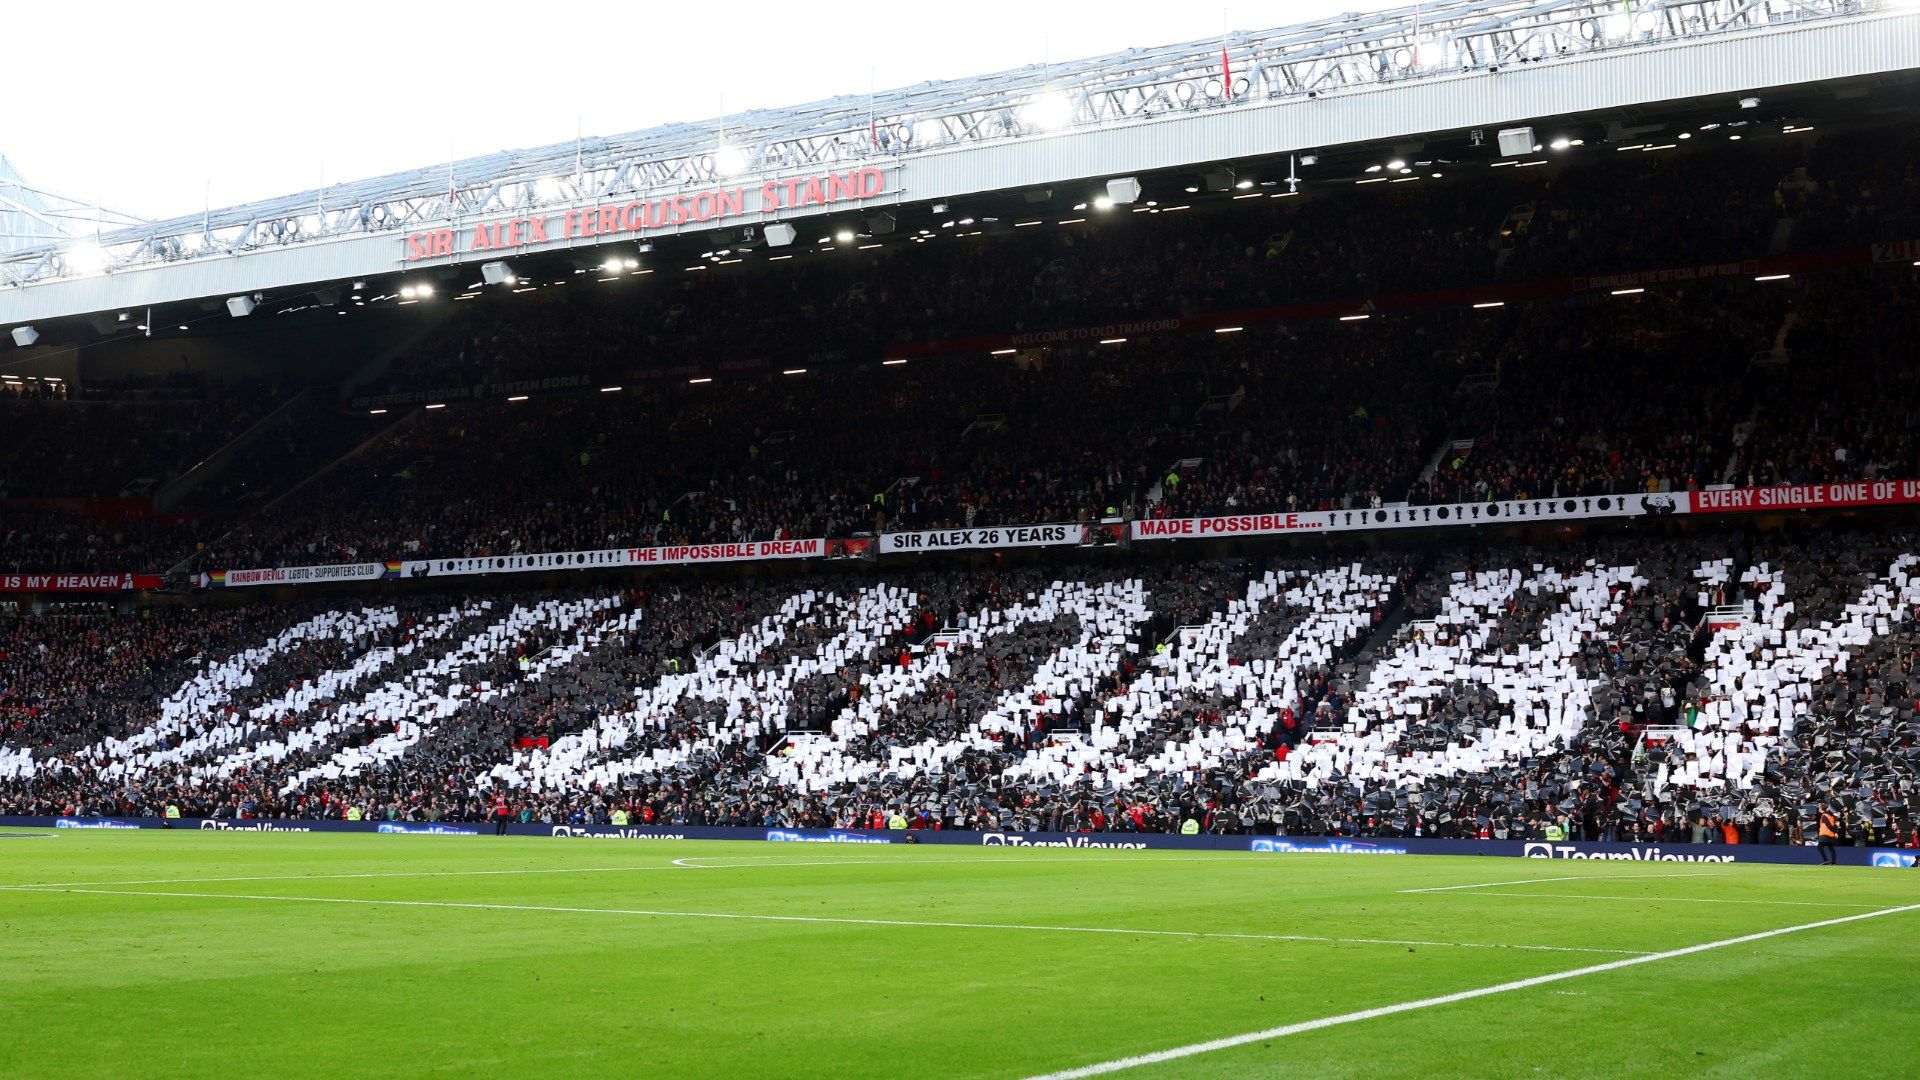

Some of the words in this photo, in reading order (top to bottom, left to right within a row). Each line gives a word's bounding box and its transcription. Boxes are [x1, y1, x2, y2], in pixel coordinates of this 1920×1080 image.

[407, 229, 454, 261] SIR
[470, 215, 548, 252] ALEX
[564, 186, 744, 240] FERGUSON
[761, 167, 884, 213] STAND
[1590, 273, 1638, 289] DOWNLOAD
[1640, 271, 1658, 285] THE
[1659, 267, 1697, 281] OFFICIAL
[1698, 265, 1715, 278] APP
[1718, 263, 1740, 276] NOW
[1011, 328, 1070, 345] WELCOME
[1071, 327, 1088, 339] TO
[1091, 325, 1115, 338] OLD
[1118, 318, 1180, 336] TRAFFORD
[1699, 489, 1754, 508] EVERY
[1759, 485, 1824, 505] SINGLE
[1830, 484, 1869, 502] ONE
[1872, 482, 1896, 500] OF
[893, 534, 922, 549] SIR
[927, 530, 973, 547] ALEX
[978, 530, 999, 544] 26
[1005, 526, 1066, 543] YEARS
[1139, 519, 1194, 536] MADE
[627, 548, 657, 562] THE
[662, 543, 755, 560] IMPOSSIBLE
[761, 539, 817, 556] DREAM
[4, 576, 21, 588] IS
[26, 576, 51, 588] MY
[56, 575, 119, 588] HEAVEN
[231, 570, 261, 584] RAINBOW
[263, 569, 286, 581] DEVILS
[289, 567, 313, 580] LGBTQ+
[314, 566, 356, 579] SUPPORTERS
[357, 564, 375, 576] CLUB
